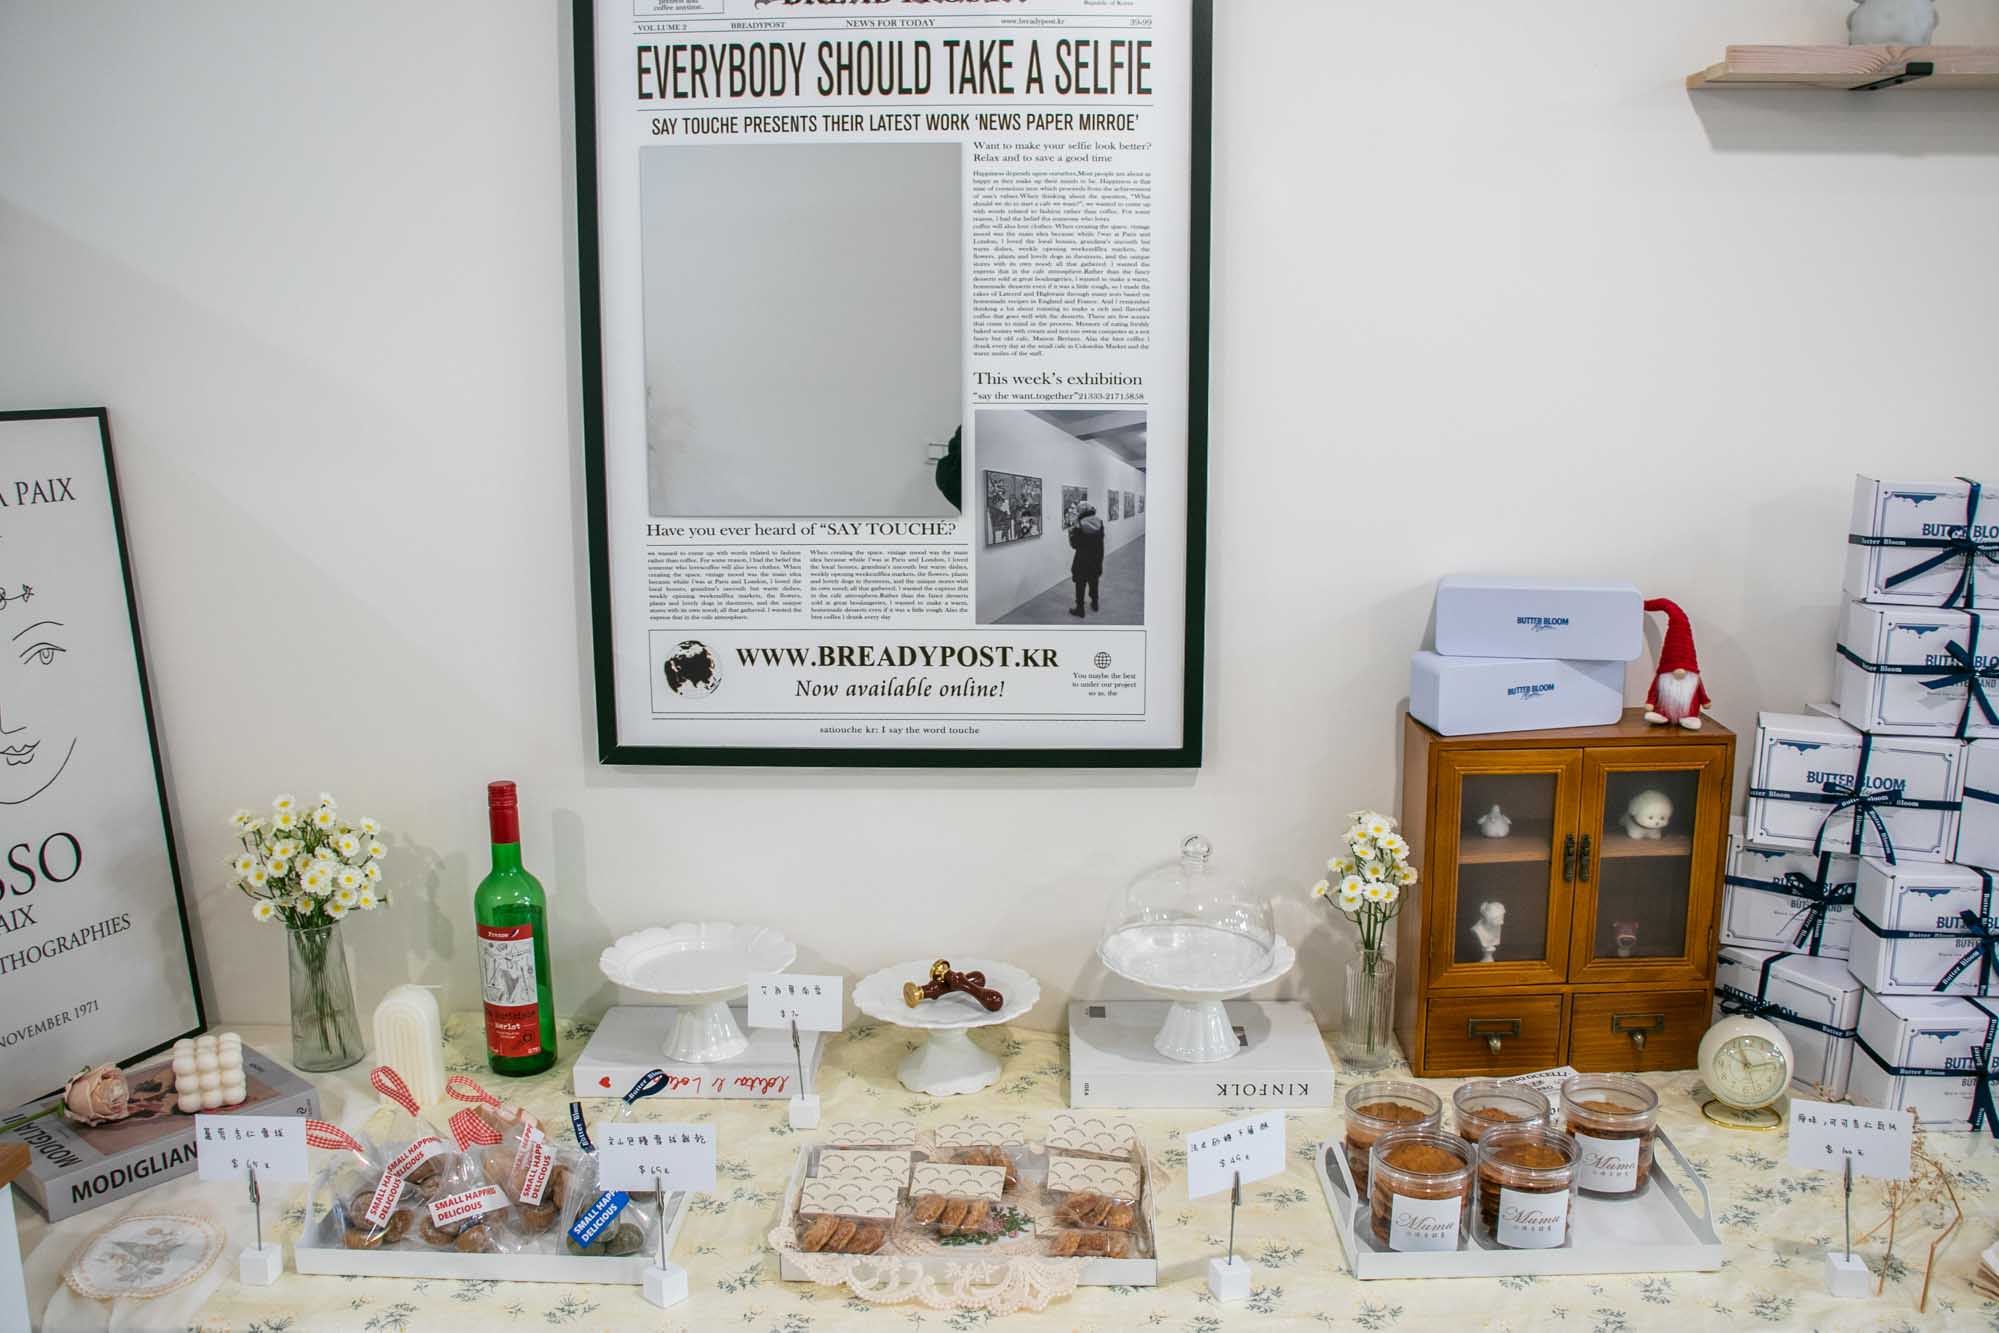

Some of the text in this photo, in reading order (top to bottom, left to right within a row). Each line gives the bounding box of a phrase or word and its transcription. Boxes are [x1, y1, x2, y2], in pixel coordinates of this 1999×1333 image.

[731, 22, 786, 30] BREADYPOST
[846, 18, 936, 28] NEWS FOR TODAY
[637, 38, 1152, 100] EVERYBODY SHOULD TAKE A SELFIE
[652, 118, 678, 135] SAY
[683, 117, 739, 134] TOUCHE
[744, 115, 817, 133] PRESENTS
[823, 114, 864, 132] THEIR
[870, 114, 920, 132] LATEST
[926, 114, 970, 131] WORK
[1026, 114, 1073, 130] PAPER
[974, 141, 1152, 152] Want to make your selfie look better?
[974, 154, 1000, 162] Relax
[1002, 154, 1020, 162] and
[1066, 154, 1088, 164] good
[1092, 154, 1112, 162] time
[973, 372, 1143, 385] This week’s exhibition
[994, 392, 1008, 400] the
[15, 477, 76, 506] PAIX
[648, 524, 684, 536] Have
[689, 527, 715, 539] you
[720, 527, 752, 536] ever
[754, 523, 796, 536] heard
[800, 522, 818, 536] of
[820, 522, 862, 536] “SAY
[1516, 616, 1568, 625] BUTTER BLOOM
[736, 645, 1059, 668] WWW.BREADYPOST.KR
[1072, 672, 1087, 680] You
[1111, 672, 1121, 680] the
[796, 678, 1005, 698] Now available online!
[1508, 686, 1530, 696] BUTTER
[1532, 683, 1554, 692] BLOOM
[889, 728, 903, 736] say
[906, 726, 920, 734] the
[923, 726, 946, 734] word
[949, 726, 980, 734] touche
[1863, 776, 1906, 790] LOOM
[74, 1000, 100, 1020] 1971
[1216, 1082, 1309, 1096] KINFOLK
[388, 1153, 408, 1172] SMALL
[523, 1169, 537, 1198] SMALL
[532, 1154, 551, 1200] DELICIOUS
[370, 1188, 386, 1216] SMALL
[379, 1179, 402, 1220] DELICIOUS
[434, 1196, 464, 1210] SMALL
[438, 1201, 482, 1220] DELICIOUS
[574, 1208, 600, 1235] SMALL
[581, 1204, 618, 1242] DELICIOUS
